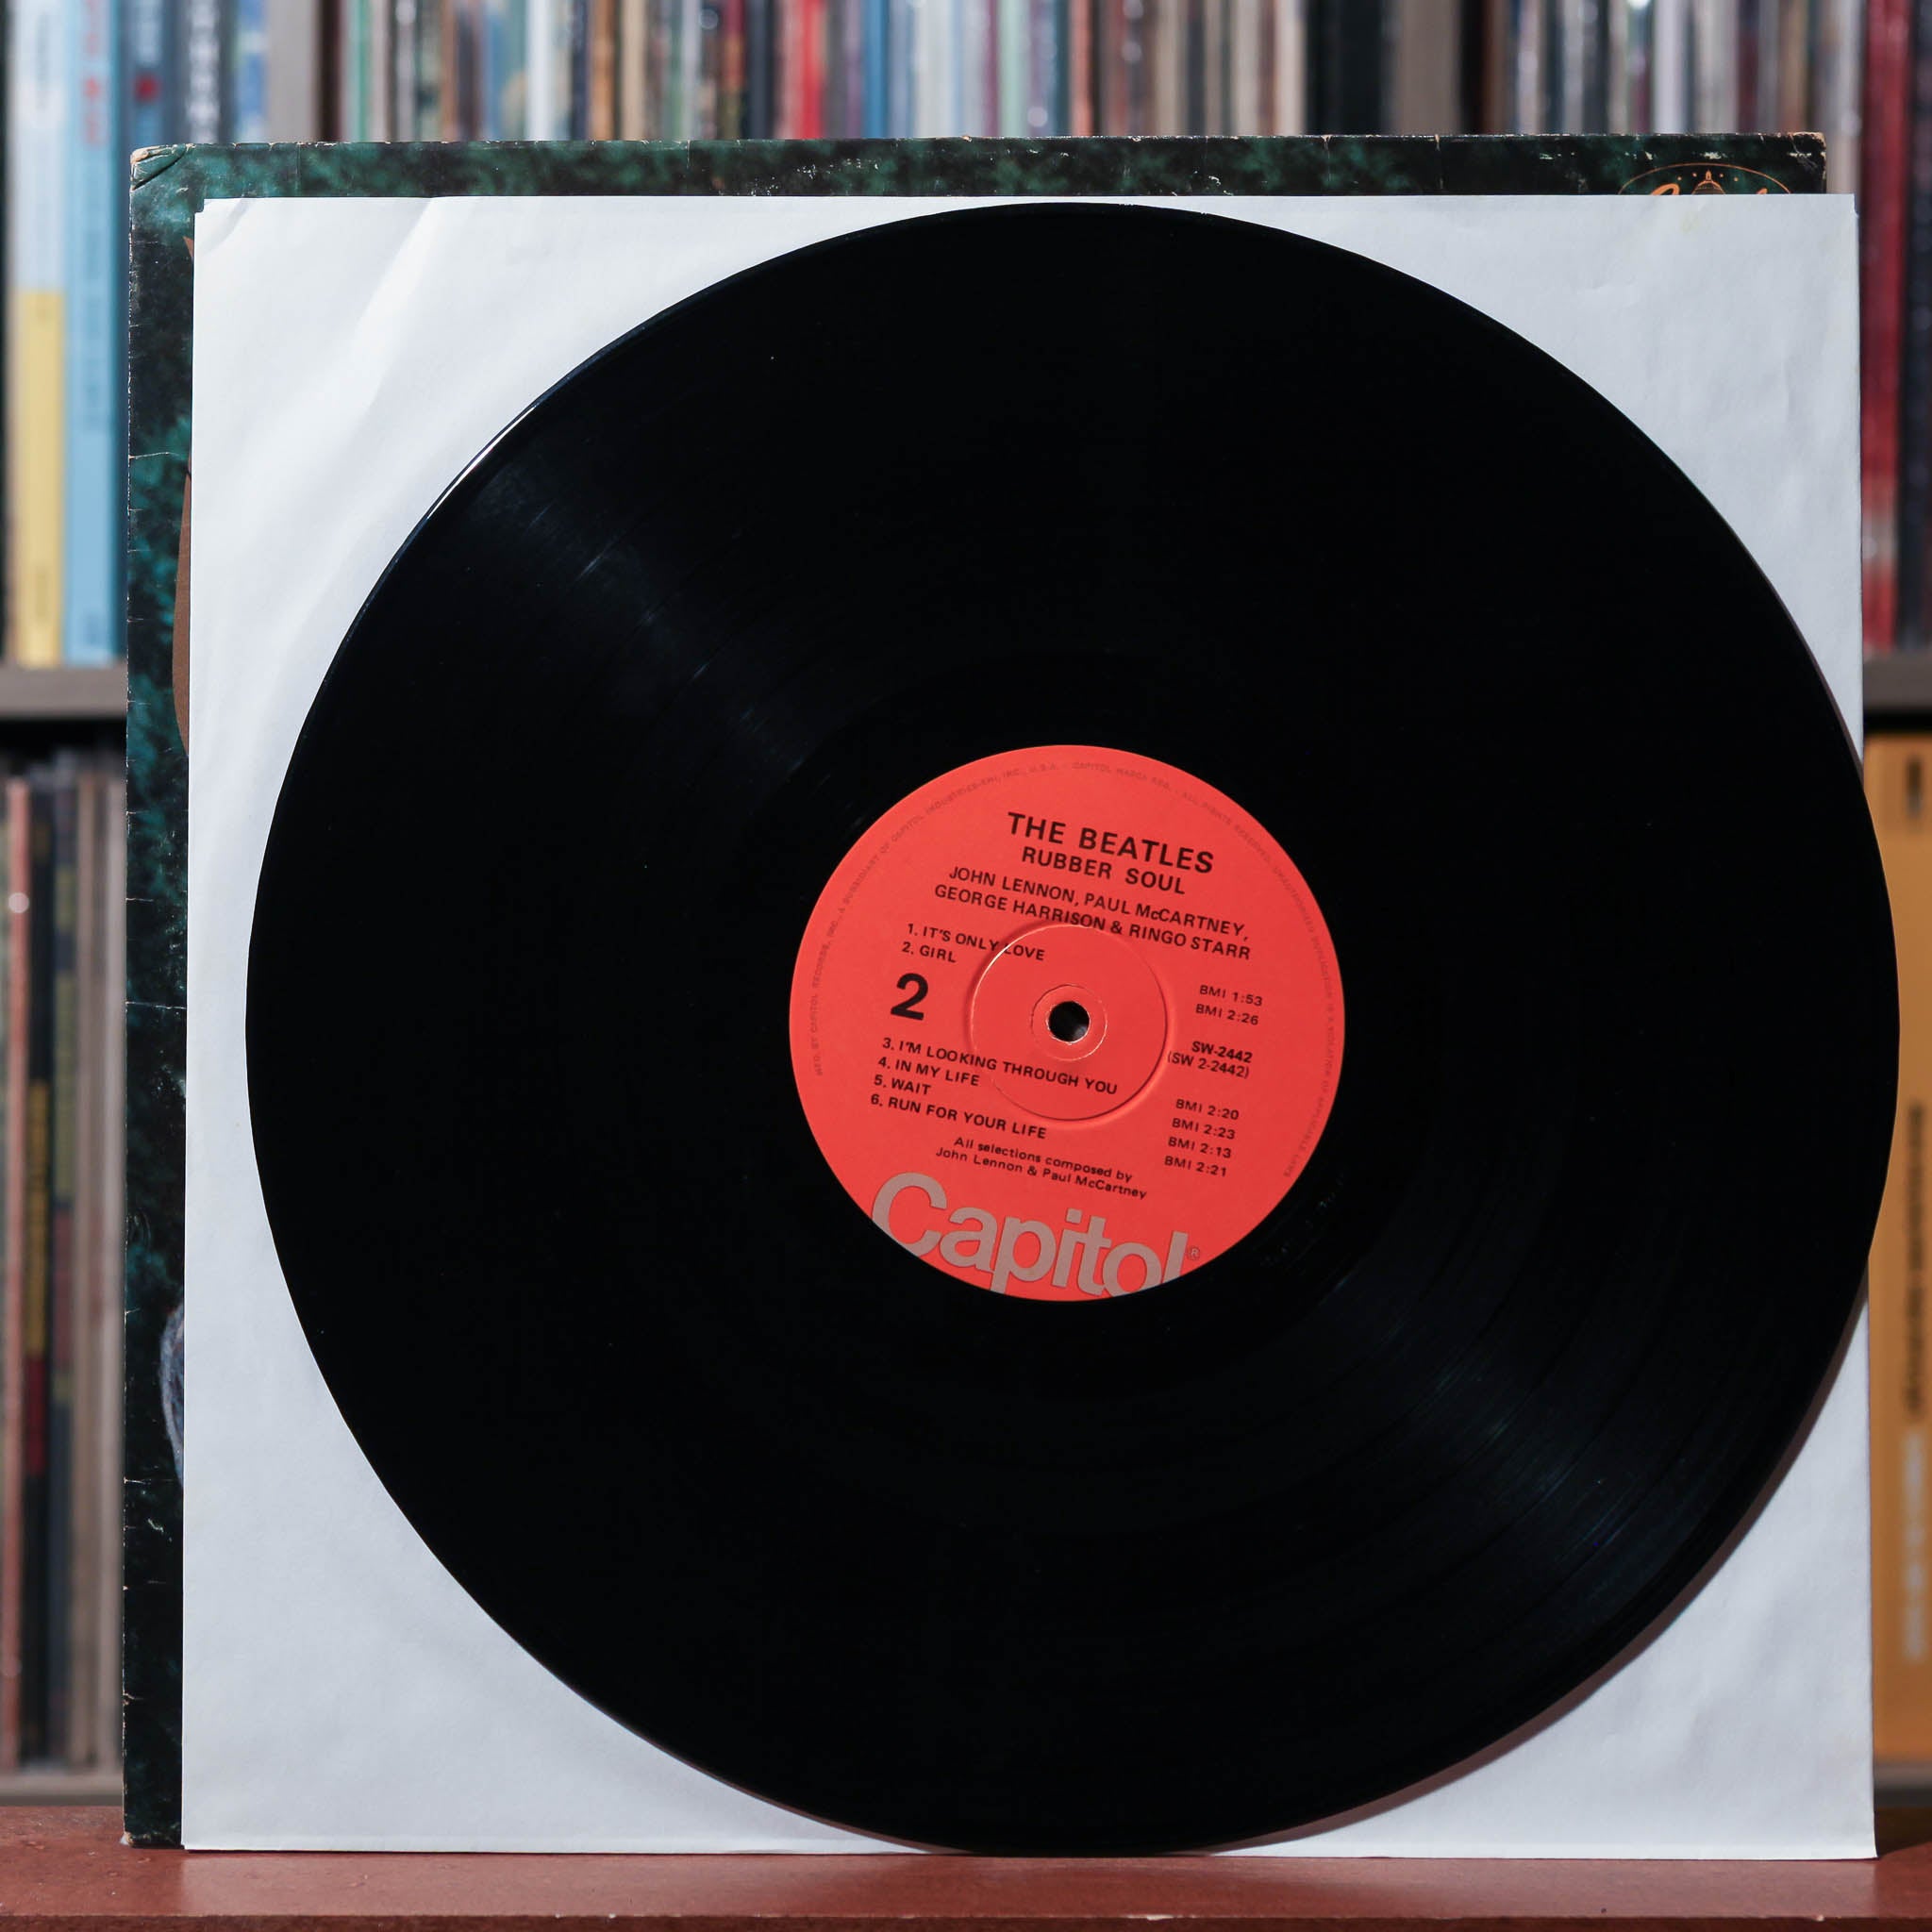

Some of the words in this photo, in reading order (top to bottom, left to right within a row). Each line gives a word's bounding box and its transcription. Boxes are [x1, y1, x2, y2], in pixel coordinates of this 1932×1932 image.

[1007, 811, 1067, 845] THE
[1078, 826, 1214, 874] BEATLES
[1021, 845, 1113, 880] RUBBER
[1124, 867, 1186, 895] SOUL
[948, 866, 996, 888] JOHN
[1001, 875, 1079, 907] LENNON,
[1083, 892, 1130, 915] PAUL
[1135, 903, 1248, 942] McCARTNEY,
[934, 883, 1008, 911] GEORGE
[1012, 899, 1107, 931] HARRISON
[1109, 920, 1123, 935] &
[1128, 923, 1187, 947] RINGO
[1190, 936, 1251, 960] STARR
[901, 941, 914, 955] 2.
[919, 944, 957, 964] GIRL
[908, 923, 918, 937] 1.
[923, 925, 952, 942] IT'S
[955, 932, 1001, 955] ONLY
[1002, 941, 1045, 961] LOVE
[890, 972, 929, 1022] 2
[1199, 984, 1226, 999] BMI
[1233, 991, 1263, 1007] 1:53
[1195, 1003, 1223, 1018] BMI
[1226, 1009, 1259, 1025] 2:26
[882, 1037, 894, 1051] 3.
[898, 1041, 923, 1055] I'M
[925, 1045, 998, 1071] LOOKING
[1002, 1060, 1080, 1088] THROUGH
[1084, 1077, 1118, 1095] YOU
[1168, 1051, 1195, 1067] (SW
[1197, 1057, 1250, 1079] 2-2442)
[1191, 1041, 1254, 1064] SW-2442
[874, 1074, 887, 1088] 5.
[891, 1077, 932, 1095] WAIT
[877, 1056, 891, 1070] 4.
[894, 1058, 912, 1073] IN
[915, 1062, 941, 1078] MY
[944, 1069, 980, 1087] LIFE
[870, 1092, 884, 1108] 6.
[888, 1096, 922, 1114] RUN
[925, 1104, 958, 1122] FOR
[963, 1111, 1008, 1132] YOUR
[1011, 1122, 1047, 1140] LIFE
[1175, 1098, 1203, 1113] BMI
[1207, 1105, 1240, 1121] 2:20
[1172, 1117, 1199, 1132] BMI
[1203, 1124, 1236, 1141] 2:23
[953, 1136, 974, 1149] All
[977, 1142, 1041, 1163] selections
[1043, 1157, 1113, 1181] composed
[1115, 1170, 1133, 1184] by
[1167, 1136, 1195, 1150] BMI
[1199, 1142, 1232, 1159] 2:13
[935, 1146, 968, 1161] John
[973, 1154, 1024, 1173] Lennon
[1026, 1164, 1038, 1176] &
[1042, 1167, 1072, 1183] Paul
[1074, 1174, 1147, 1200] McCartney
[1163, 1155, 1192, 1170] BMI
[1195, 1161, 1227, 1177] 2:21
[872, 1172, 1189, 1297] Capitol
